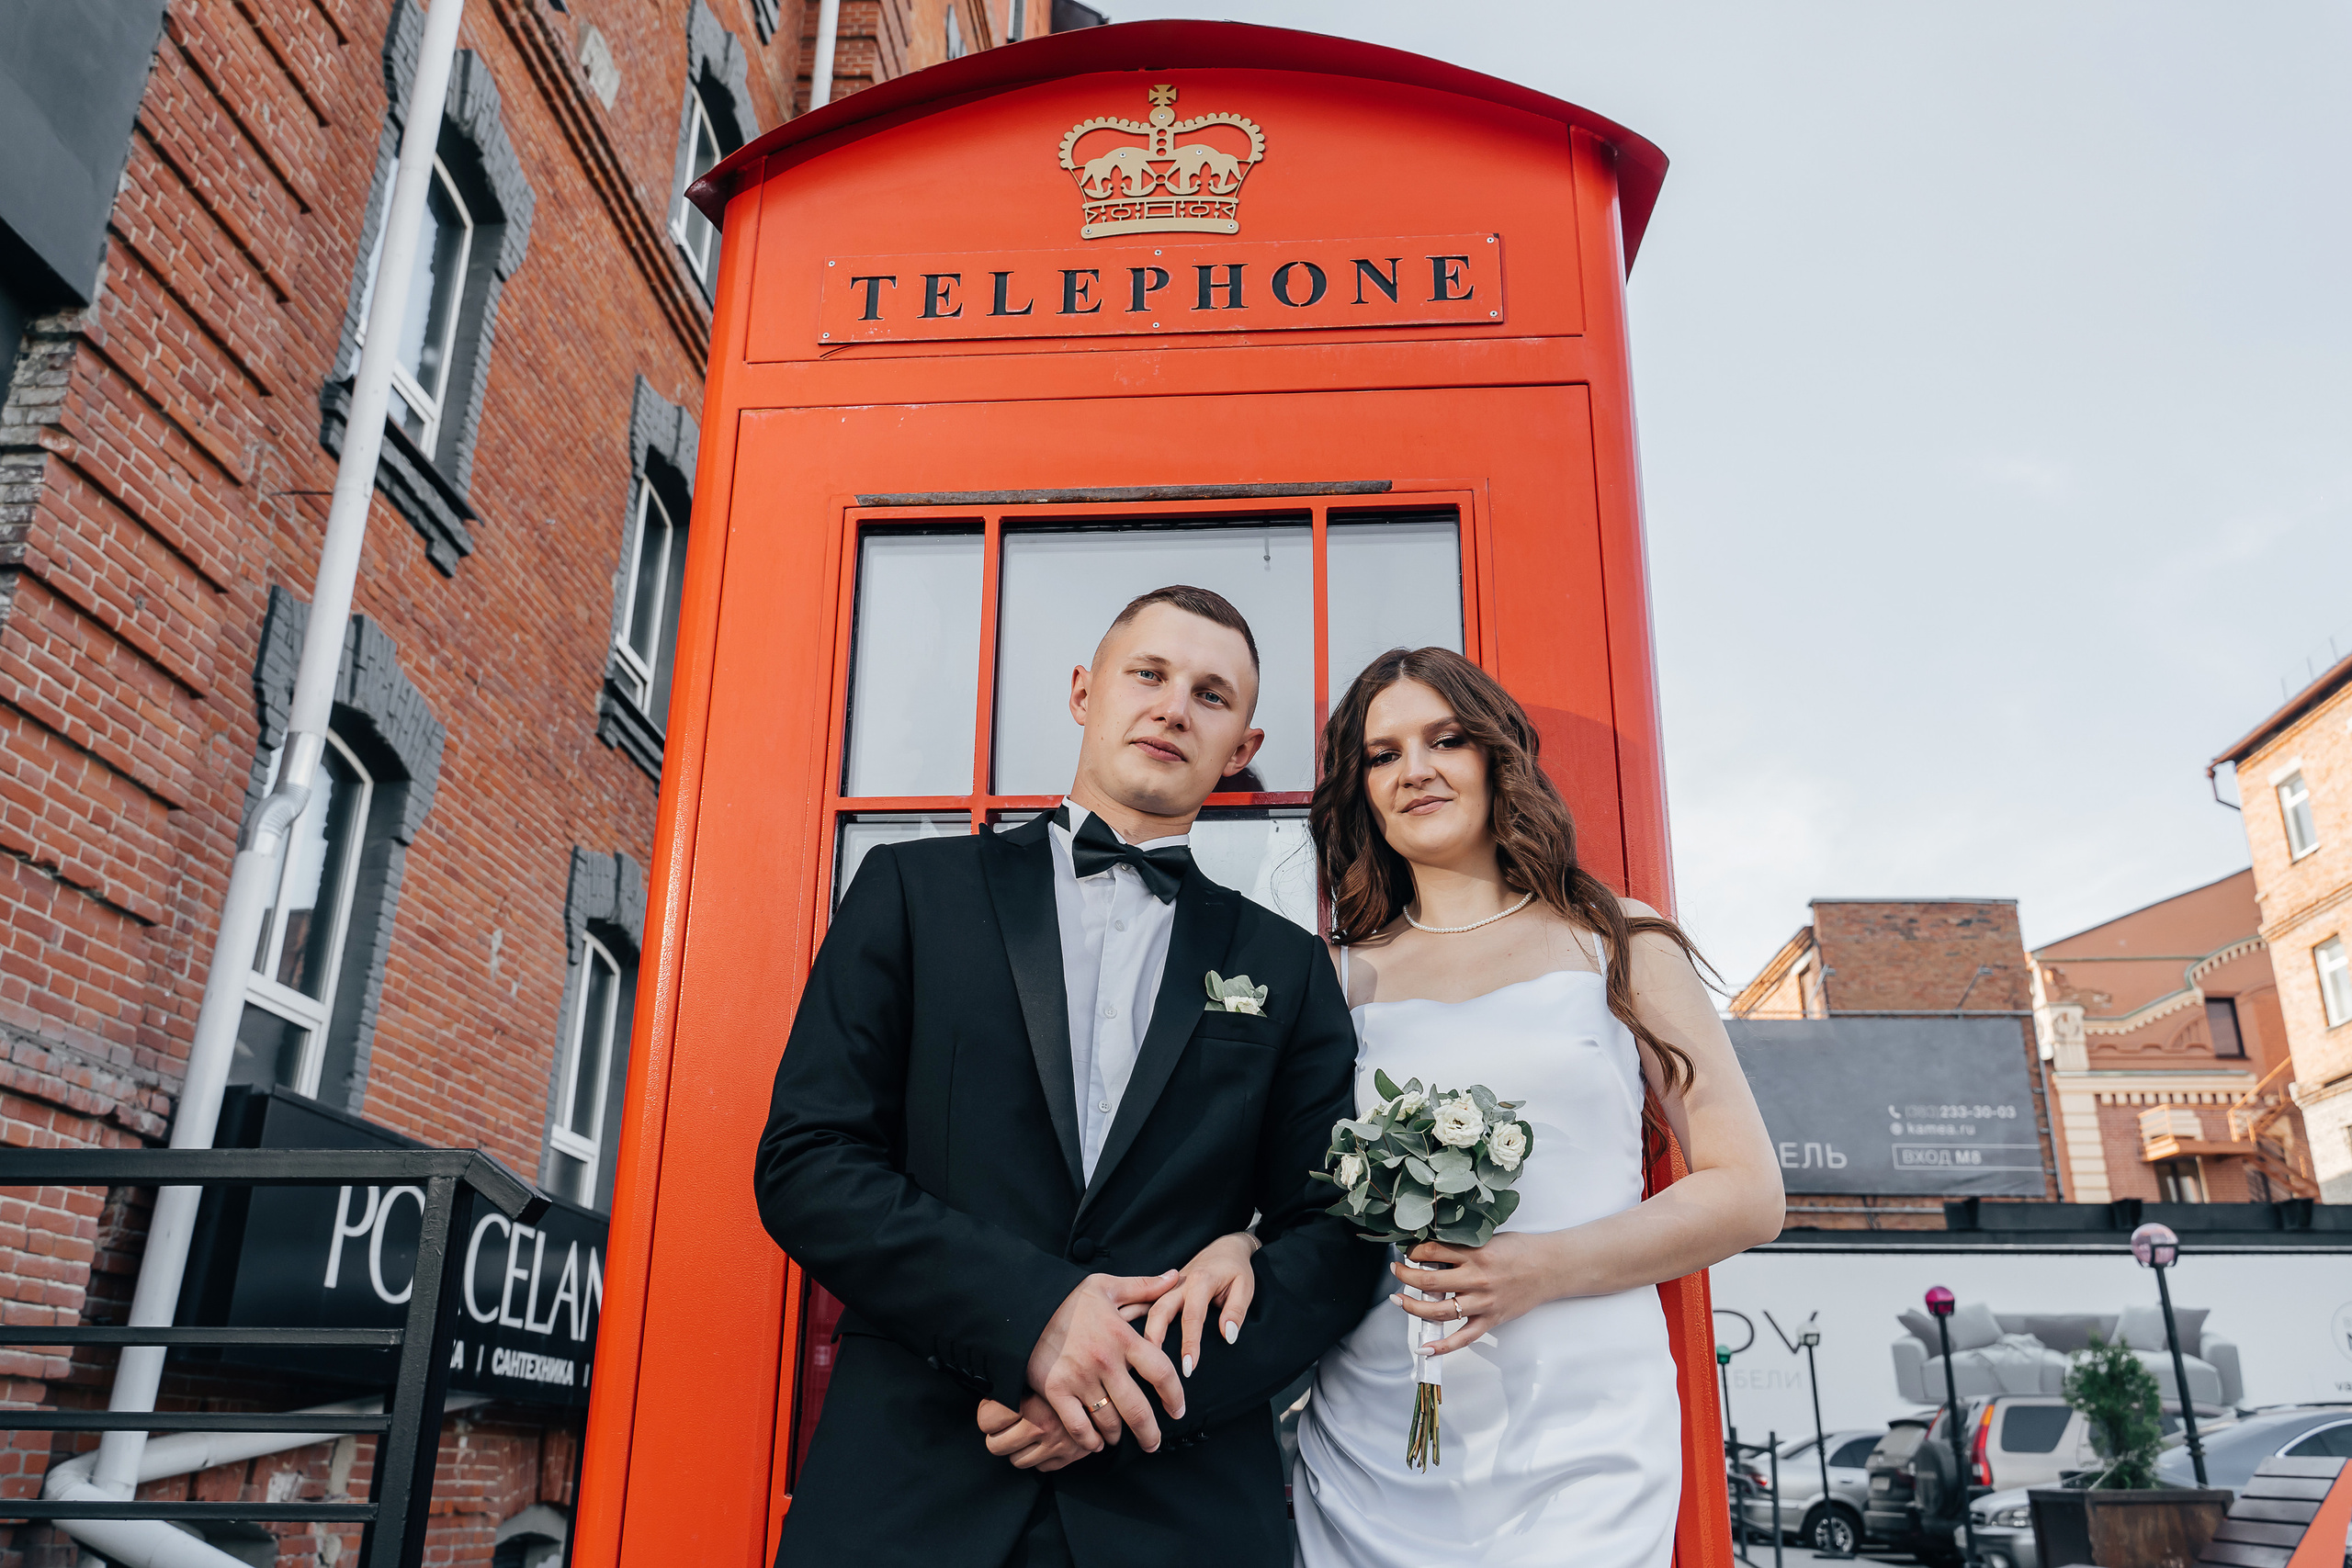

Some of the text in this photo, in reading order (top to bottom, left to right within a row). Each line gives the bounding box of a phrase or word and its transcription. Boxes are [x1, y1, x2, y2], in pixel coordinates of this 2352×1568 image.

[850, 254, 1475, 321] TELEPHONE
[1905, 1122, 1975, 1135] kamea.ru
[1902, 1149, 1952, 1166] ВХОД
[323, 1186, 604, 1342] POCELAN
[492, 1347, 574, 1386] САНТЕХНИКА
